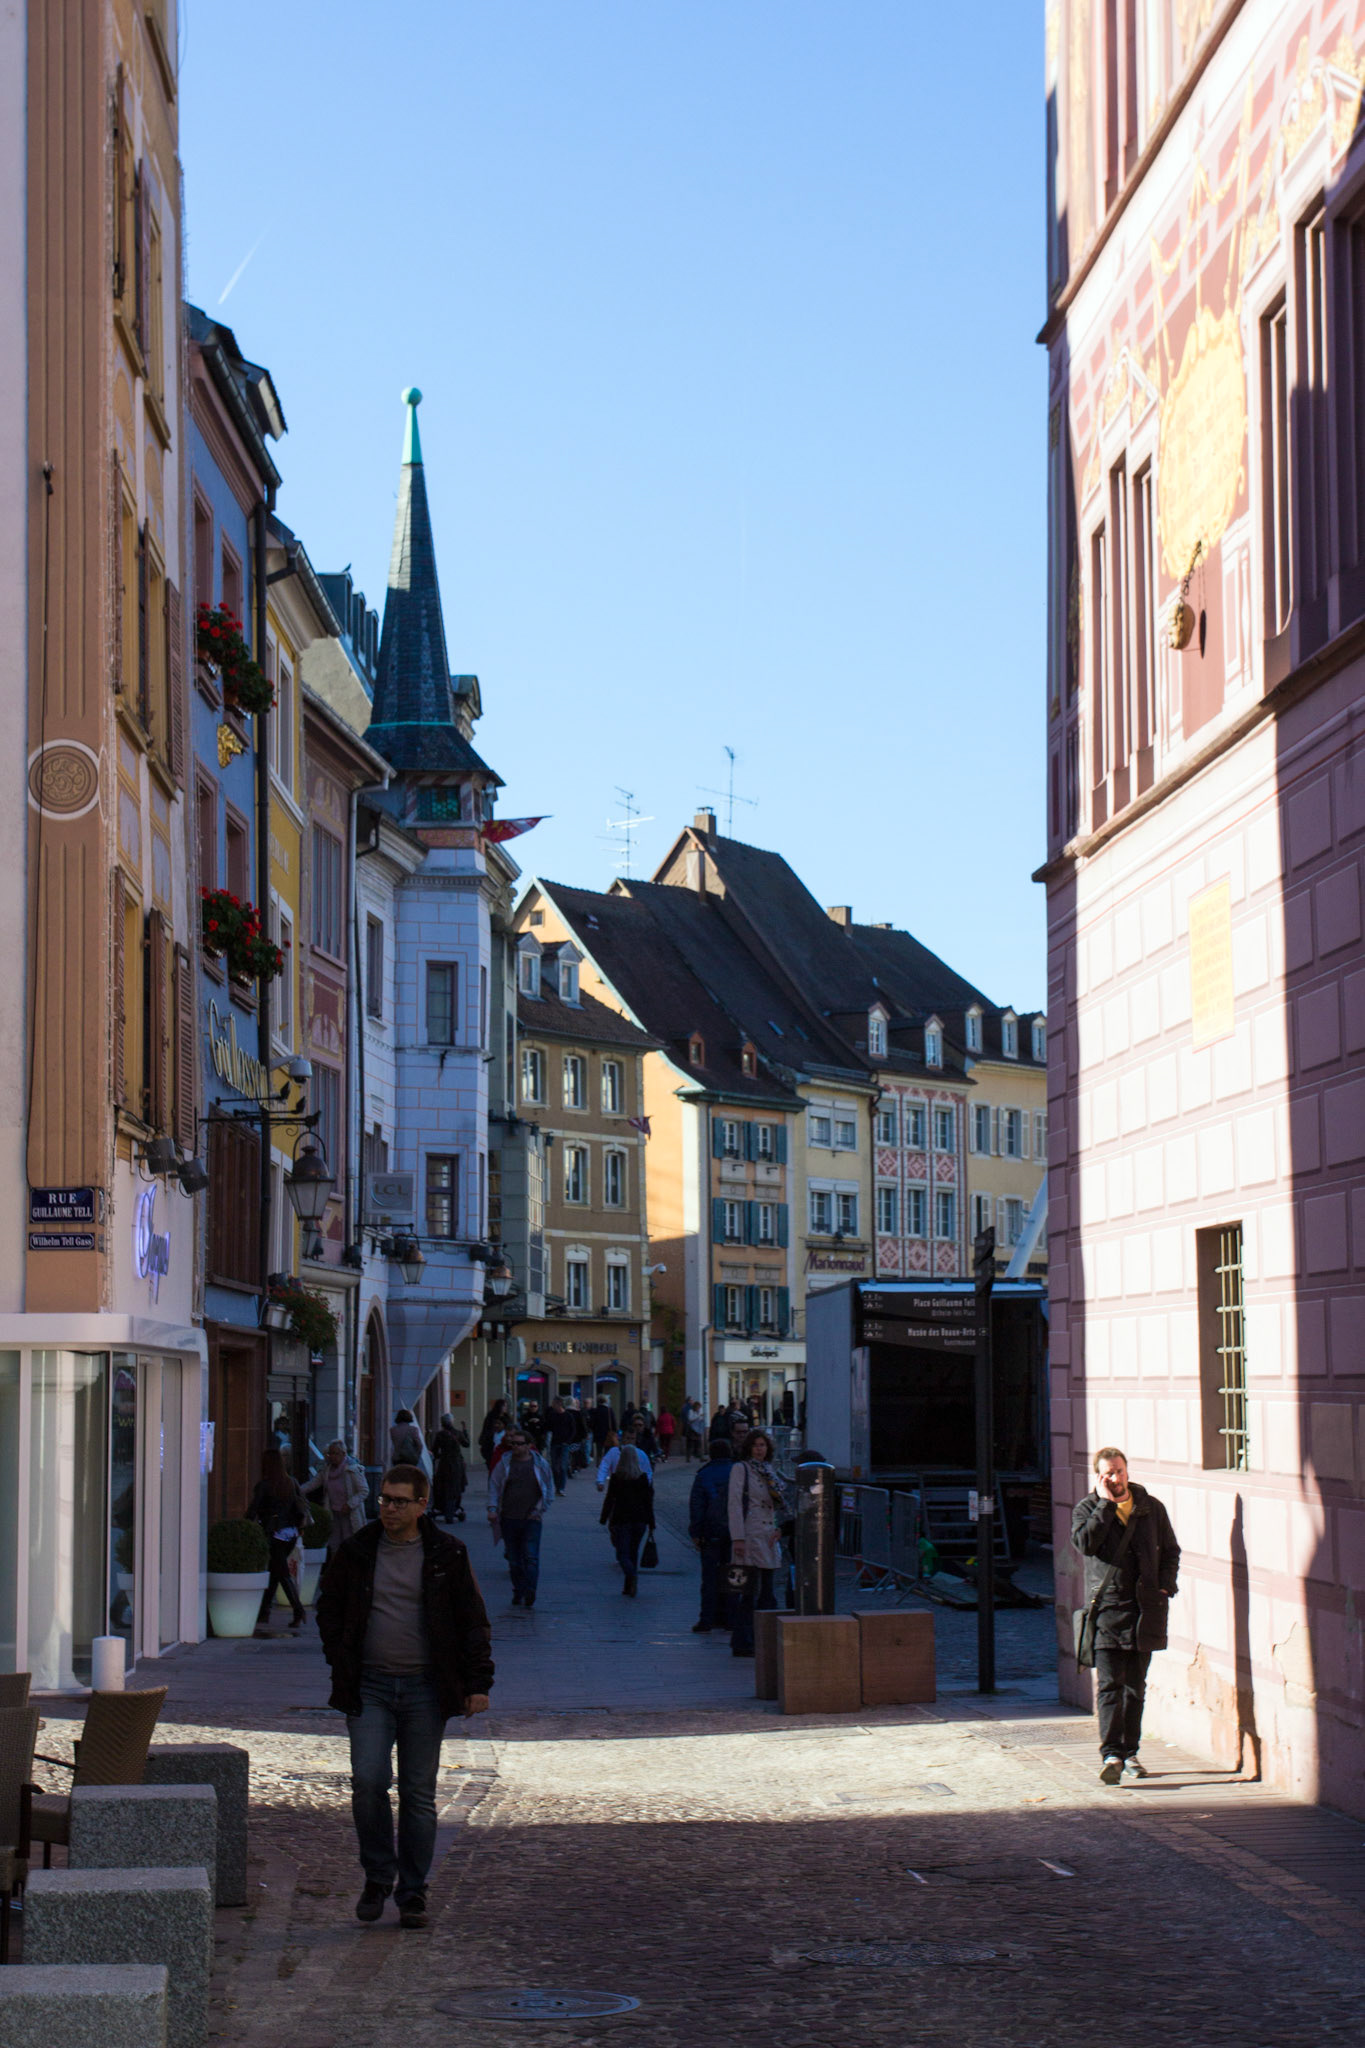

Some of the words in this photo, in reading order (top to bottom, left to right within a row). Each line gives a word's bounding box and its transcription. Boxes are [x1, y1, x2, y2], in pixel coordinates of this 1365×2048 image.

[375, 1184, 409, 1196] LCL
[48, 1193, 77, 1204] RUE
[32, 1206, 73, 1218] GUILLAUME
[74, 1206, 93, 1218] TELL
[32, 1236, 60, 1247] Wilhelm
[61, 1236, 75, 1246] Tell
[75, 1236, 92, 1246] Gass
[535, 1342, 573, 1353] BANQUE
